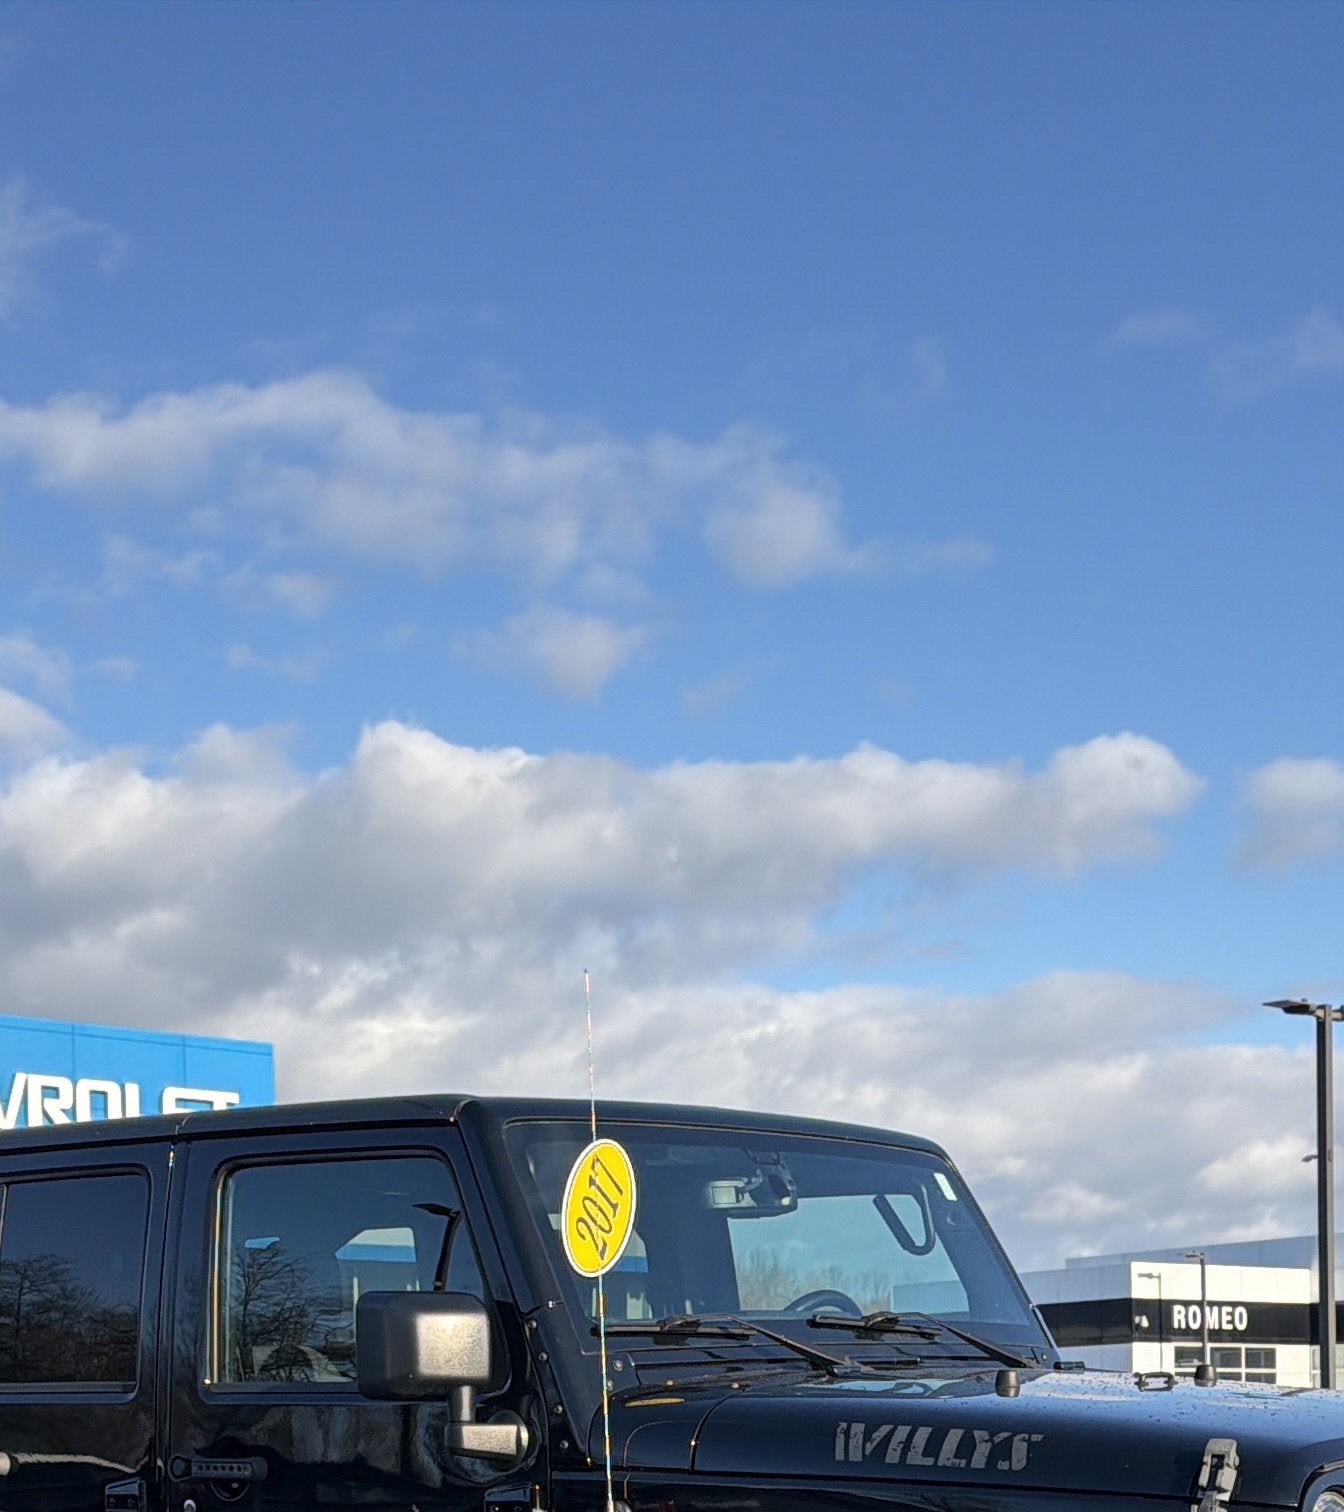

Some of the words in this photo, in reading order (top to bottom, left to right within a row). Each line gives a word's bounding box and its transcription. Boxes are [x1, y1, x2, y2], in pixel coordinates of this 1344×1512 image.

[576, 1153, 623, 1260] 2017
[1172, 1304, 1248, 1331] ROMEO
[834, 1421, 1045, 1471] WILLYS
